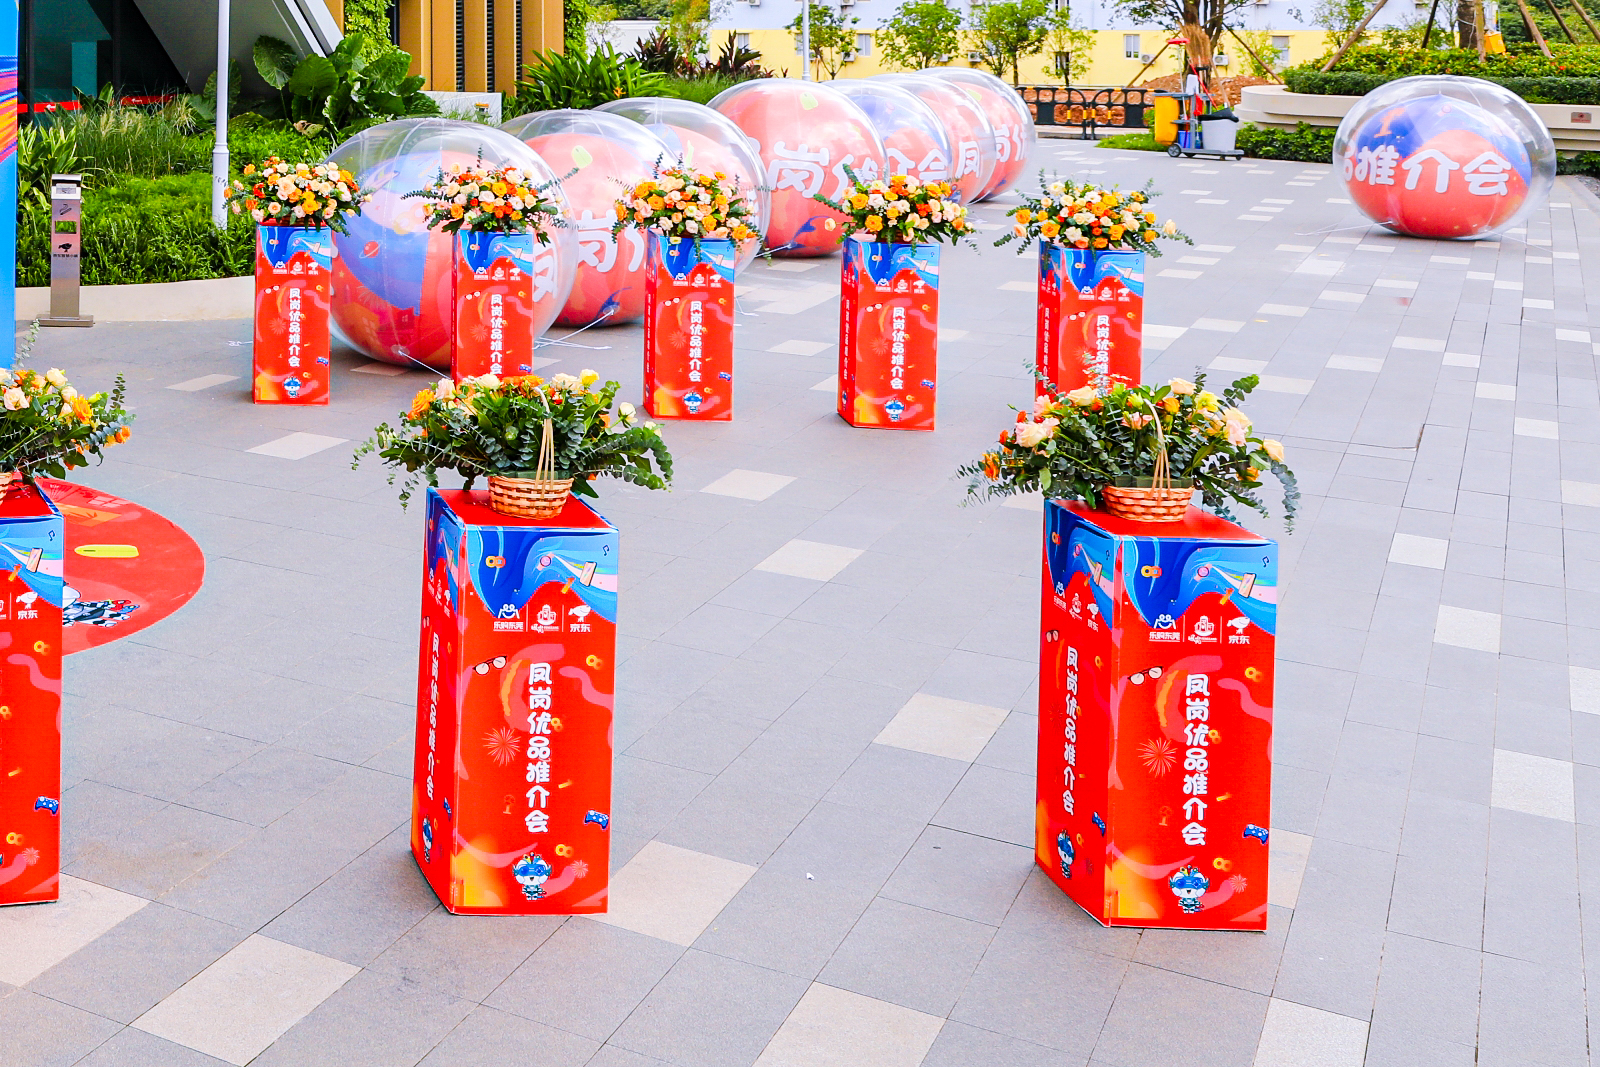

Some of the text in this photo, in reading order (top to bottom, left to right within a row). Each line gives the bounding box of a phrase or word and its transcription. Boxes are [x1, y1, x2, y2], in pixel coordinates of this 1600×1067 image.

[288, 288, 302, 367] 凤岗优品推介会
[689, 300, 703, 382] 凤岗优品推介会
[891, 307, 906, 389] 凤岗优品推介会
[18, 610, 39, 620] 京东
[570, 623, 591, 633] 京东
[1229, 635, 1250, 645] 京东
[525, 663, 553, 833] 凤岗优品推介会
[1063, 646, 1078, 816] 凤岗优品推介会
[1182, 674, 1211, 845] 凤岗优品推介会
